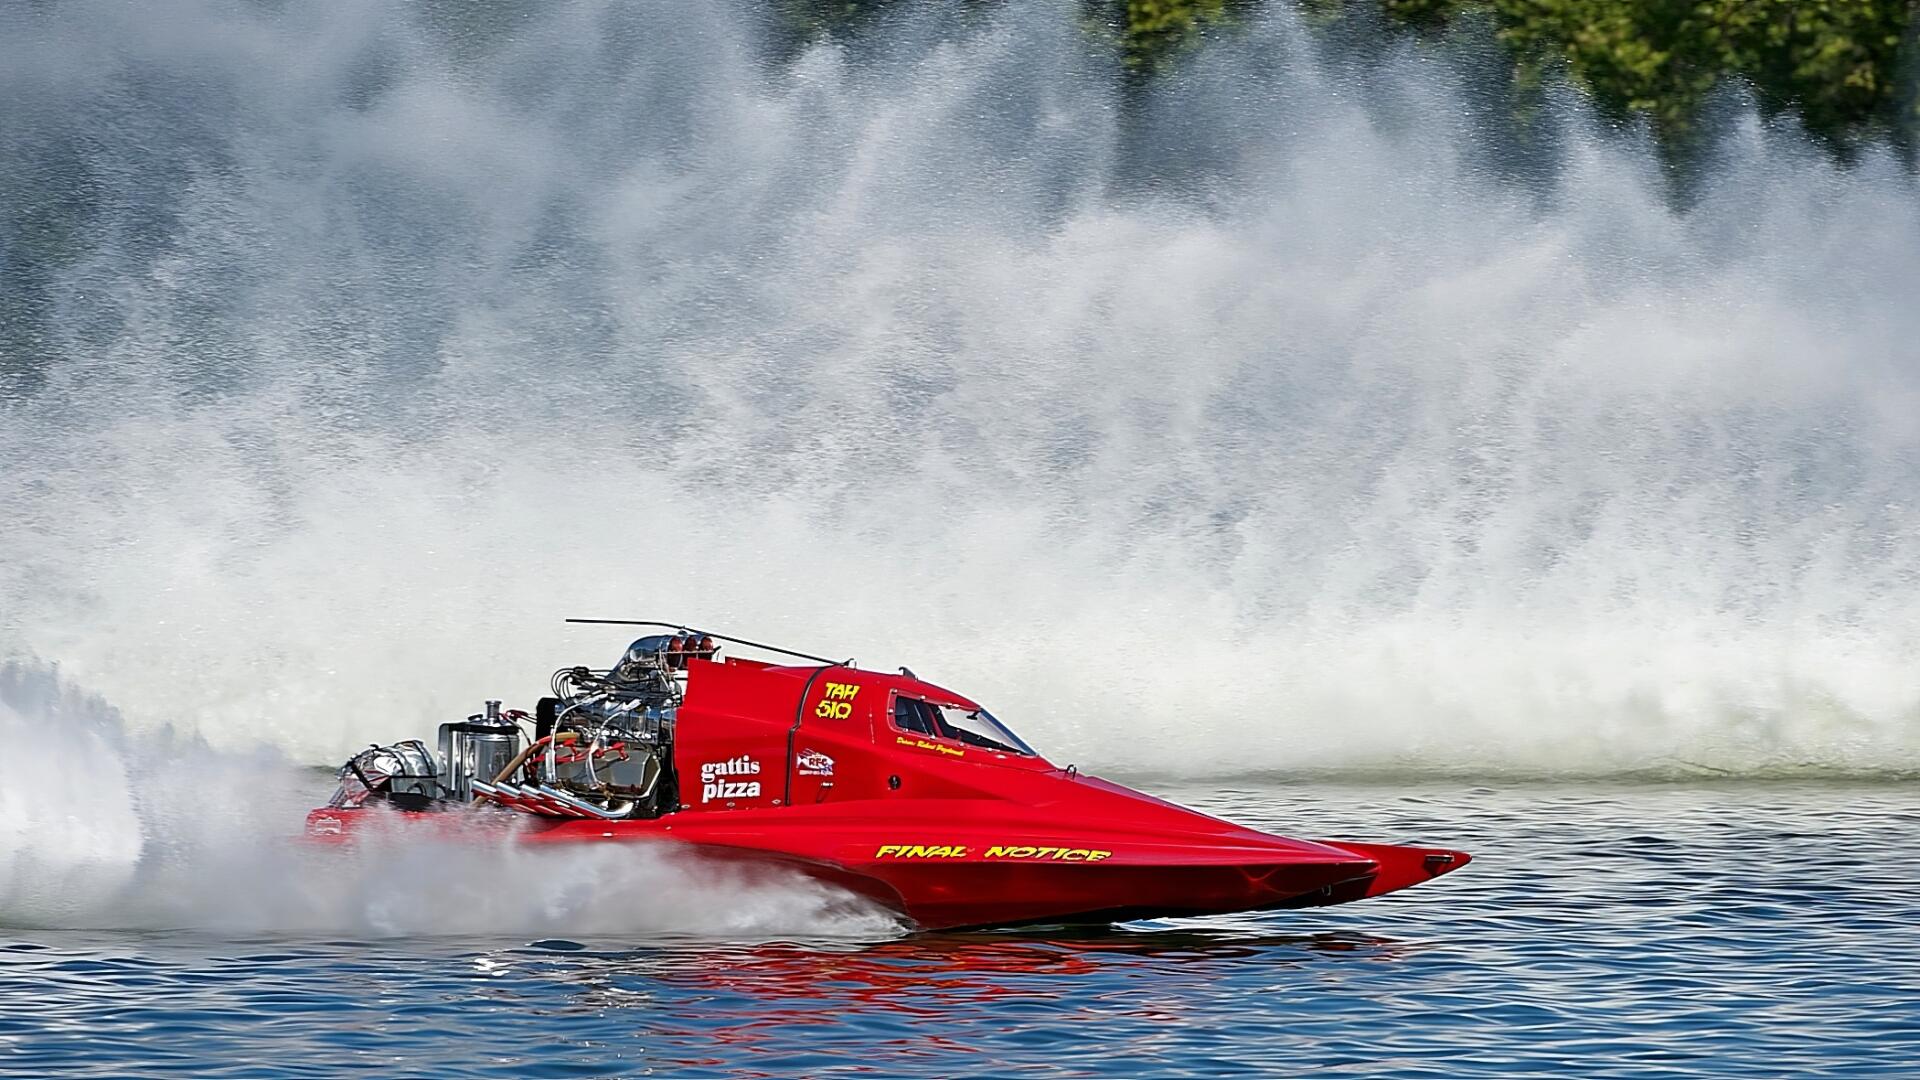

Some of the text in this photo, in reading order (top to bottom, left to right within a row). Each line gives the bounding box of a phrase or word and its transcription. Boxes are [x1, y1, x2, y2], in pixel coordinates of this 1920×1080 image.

[825, 682, 861, 700] TAH
[815, 699, 852, 719] 510
[701, 754, 761, 783] gattis
[701, 778, 761, 803] pizza
[876, 845, 1112, 862] FINAL NOTICE
